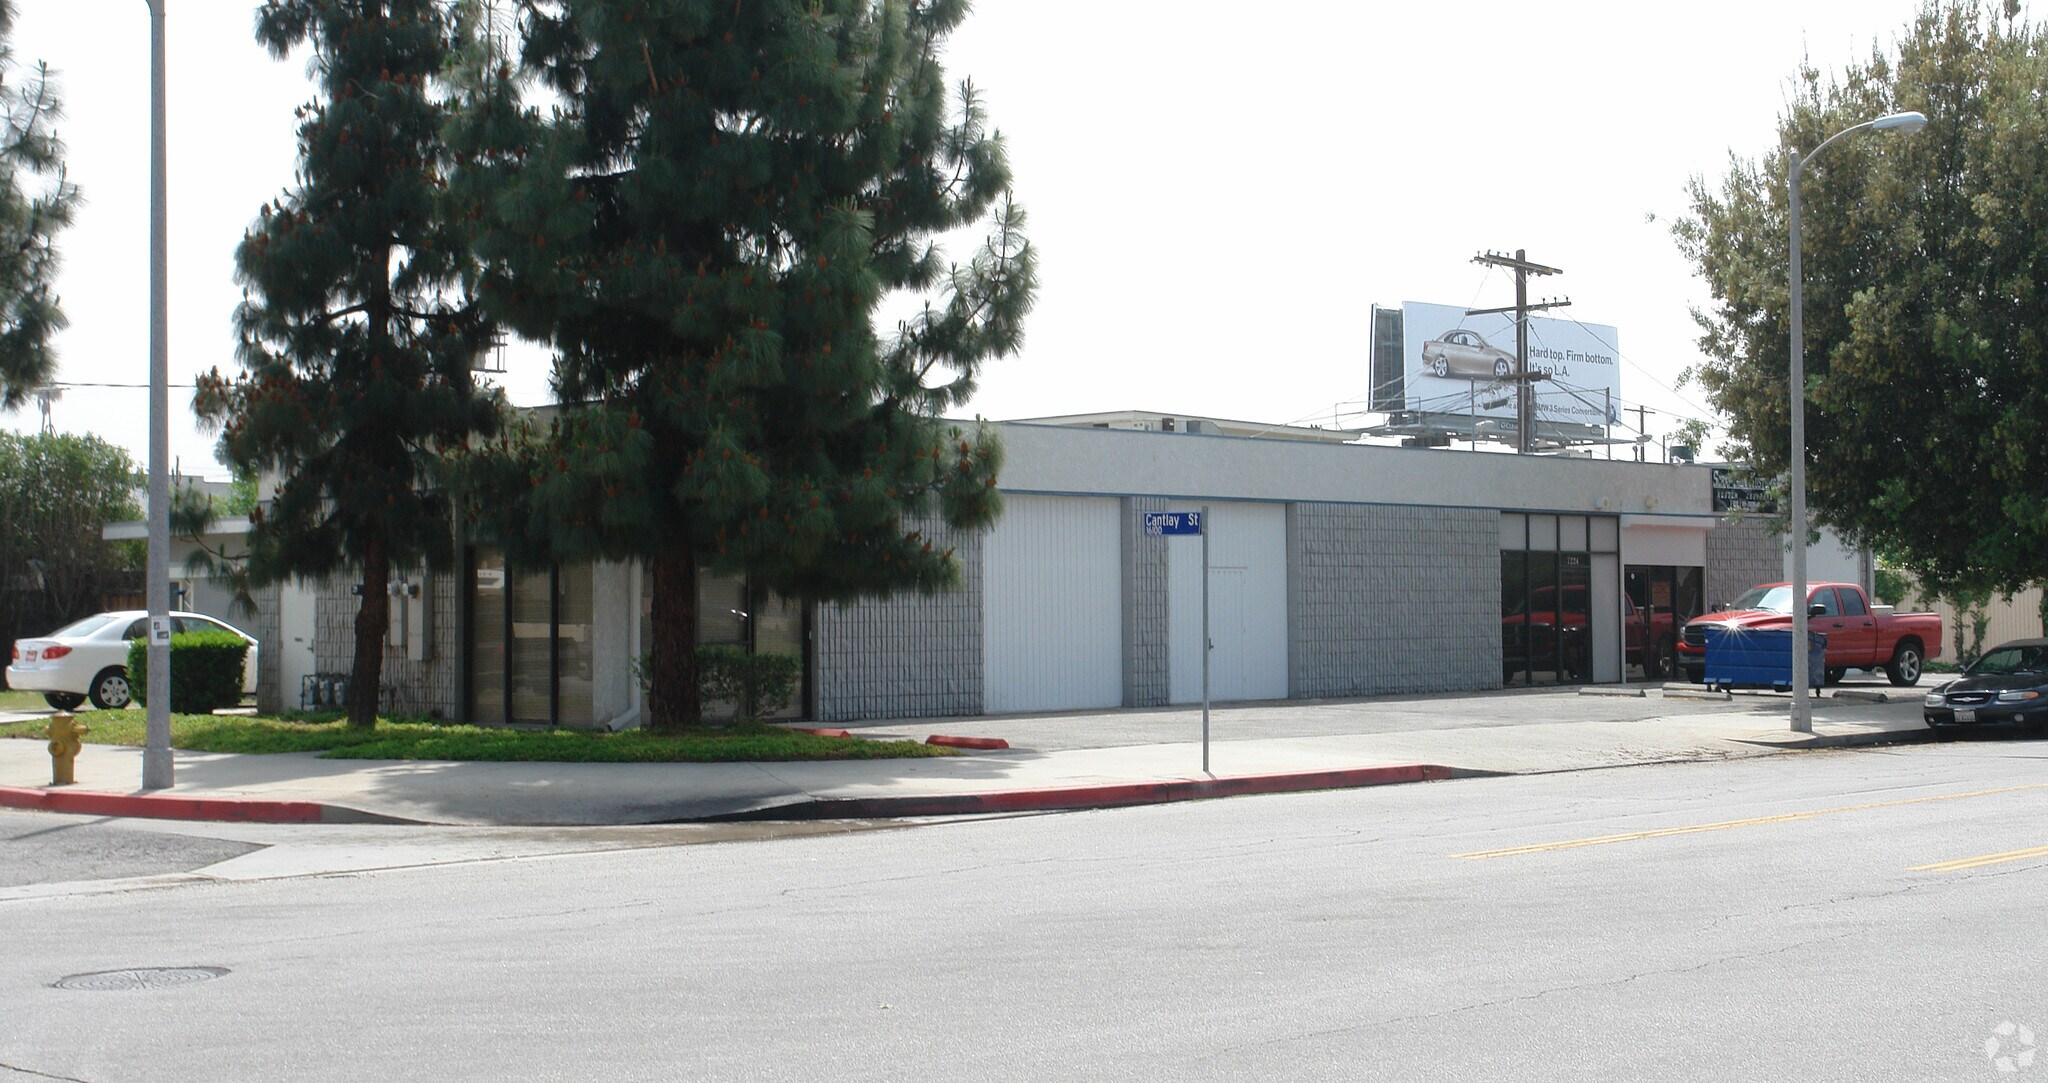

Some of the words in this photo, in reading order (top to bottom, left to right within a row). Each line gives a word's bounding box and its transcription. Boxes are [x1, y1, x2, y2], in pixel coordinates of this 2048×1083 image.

[1529, 345, 1548, 358] Hard
[1549, 348, 1565, 362] top.
[1566, 349, 1583, 362] Firm
[1584, 352, 1613, 365] bottom.
[1529, 361, 1541, 373] It's
[1543, 365, 1553, 375] so
[1554, 364, 1570, 376] L.A.
[1554, 405, 1571, 414] Series
[1146, 513, 1179, 529] Cantlay
[1188, 513, 1199, 526] St
